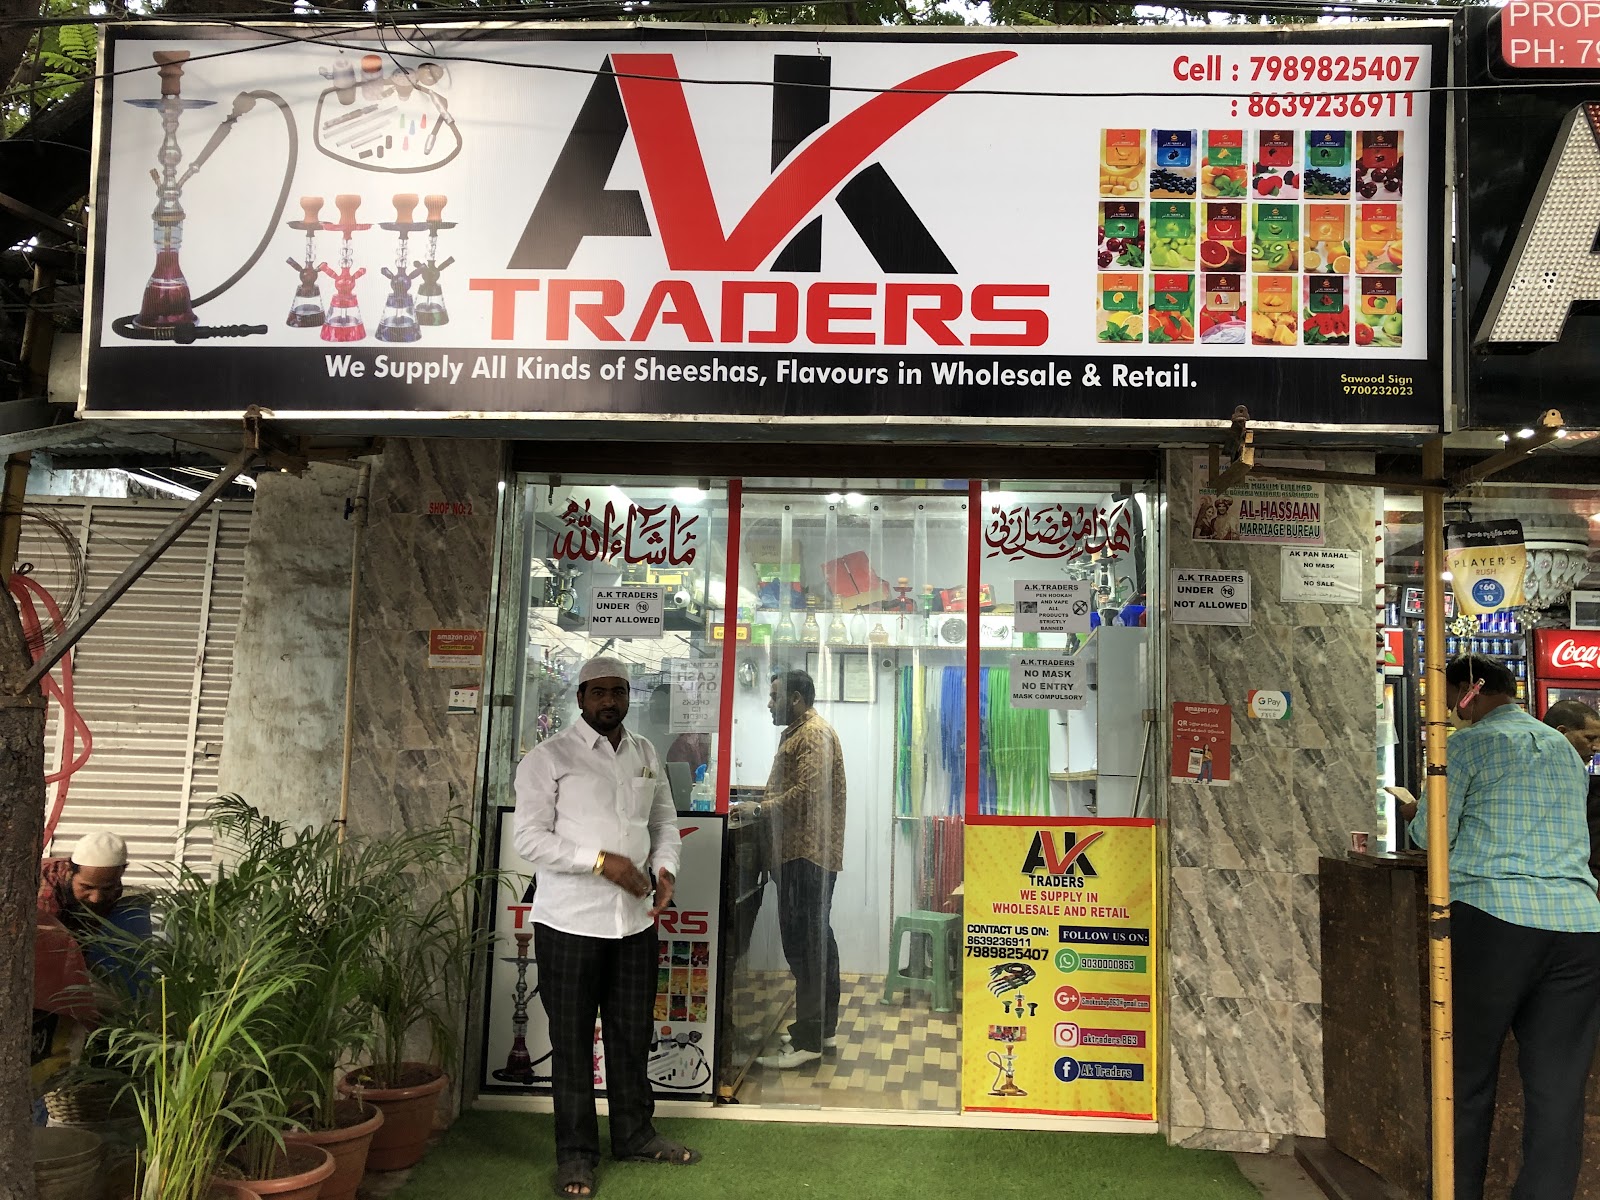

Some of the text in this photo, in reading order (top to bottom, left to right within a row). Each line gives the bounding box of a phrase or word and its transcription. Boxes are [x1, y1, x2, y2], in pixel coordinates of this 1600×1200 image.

[1511, 39, 1564, 64] PH:
[1173, 55, 1221, 81] Cell
[1250, 55, 1420, 81] 7989825407
[1248, 92, 1413, 117] 8639236911
[470, 278, 1050, 346] TRADERS
[325, 354, 1197, 388] We Supply All Kinds of Sheeshas, Flavours in Wholesale & Retail.
[1340, 374, 1413, 386] Sawood Sign
[1343, 386, 1413, 395] 9700232023
[429, 502, 450, 515] SHOP
[467, 503, 473, 515] 2
[1240, 500, 1320, 520] AL-HASSAAN
[1240, 522, 1320, 538] MARRIAGE BUREAU
[1476, 568, 1497, 576] RUSH
[1177, 574, 1244, 583] A.K TRADERS
[1177, 586, 1214, 594] UNDER
[1483, 594, 1494, 602] 10
[1173, 600, 1248, 610] NOT ALLOWED
[592, 616, 660, 625] NOT ALLOWED
[437, 634, 478, 643] amazon pay
[1042, 670, 1072, 678] MASK
[1022, 682, 1074, 691] NO ENTRY
[1267, 697, 1281, 707] Pay
[1177, 719, 1188, 727] QR
[1029, 875, 1084, 888] TRADERS
[1020, 889, 1098, 903] WE SUPPLY IN
[992, 903, 1130, 919] WHOLESALE AND RETAIL
[967, 924, 1049, 936] CONTACT US ON:
[967, 936, 1031, 947] 8639236911
[1063, 931, 1148, 943] FOLLOW US ON:
[964, 946, 1050, 961] 7989825407
[1081, 1064, 1133, 1078] Ak Traders
